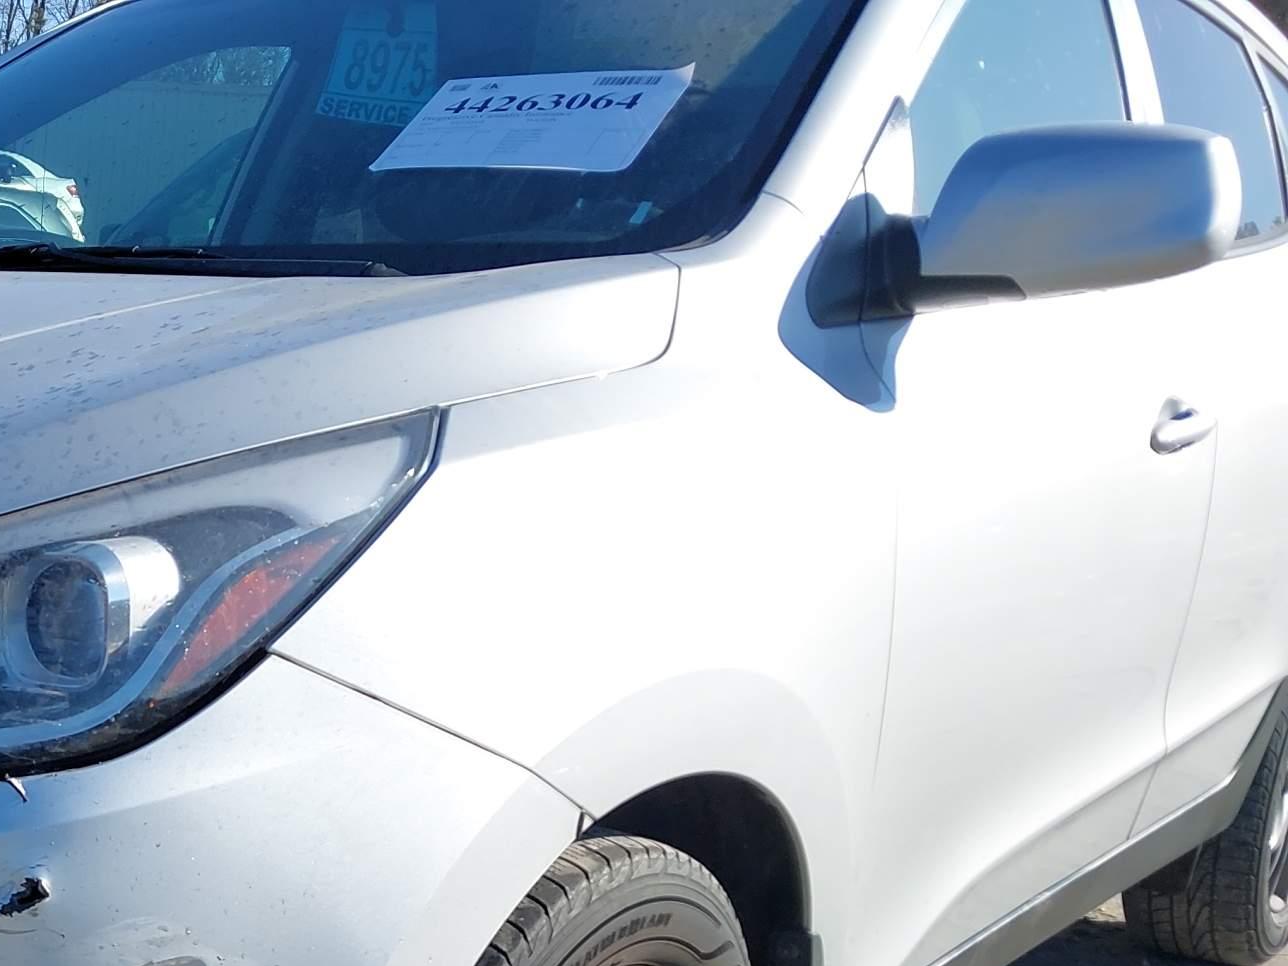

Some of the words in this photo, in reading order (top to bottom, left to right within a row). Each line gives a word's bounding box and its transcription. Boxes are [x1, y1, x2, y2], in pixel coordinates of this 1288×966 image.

[343, 39, 429, 97] 8975
[319, 97, 412, 124] SERVICE
[444, 92, 644, 114] 44263064
